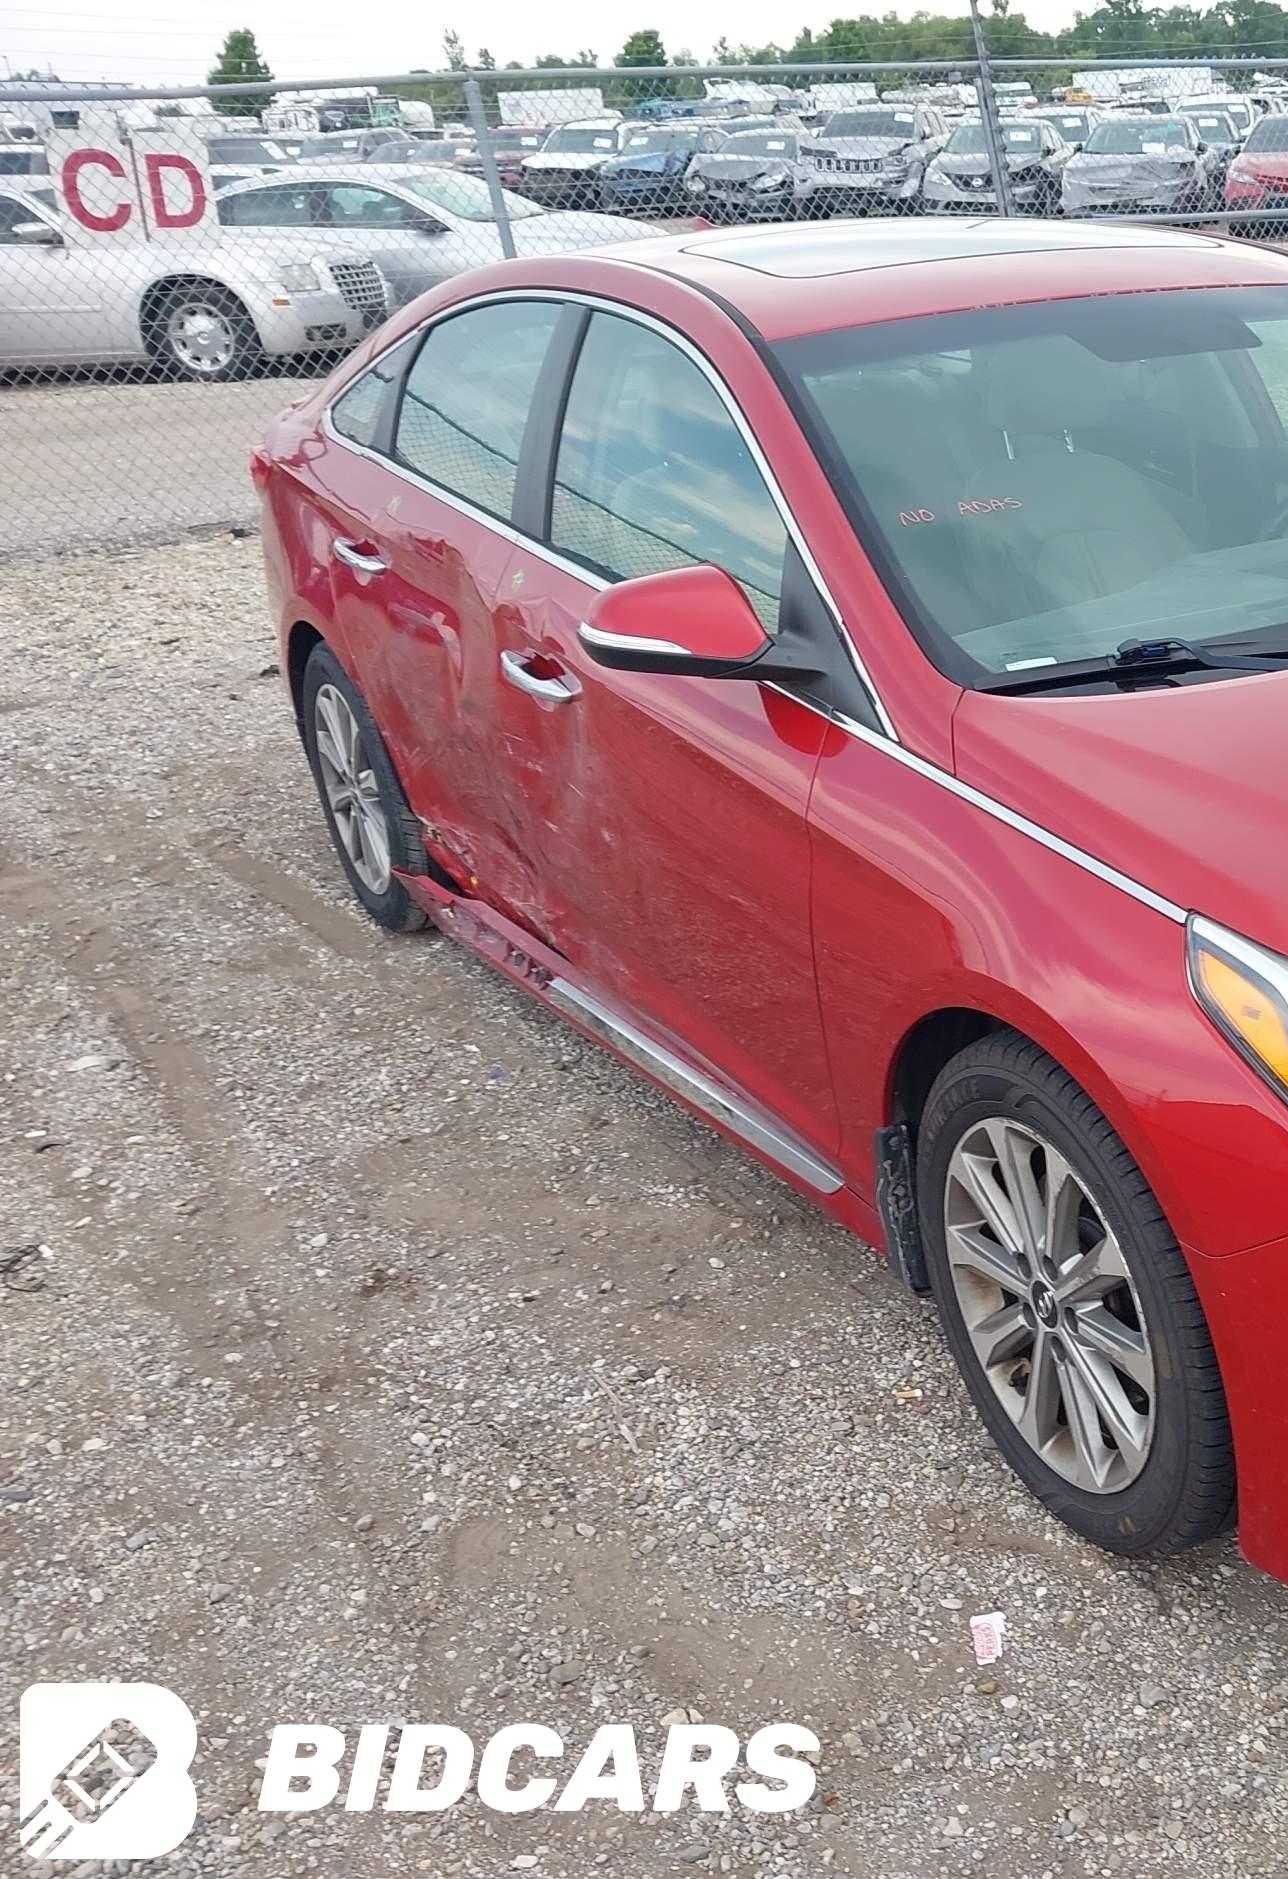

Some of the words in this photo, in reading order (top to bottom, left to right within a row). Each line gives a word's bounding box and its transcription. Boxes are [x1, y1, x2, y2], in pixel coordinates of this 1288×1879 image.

[61, 148, 131, 232] C
[145, 153, 206, 229] D
[899, 508, 935, 527] NO
[957, 496, 1023, 515] ADAS
